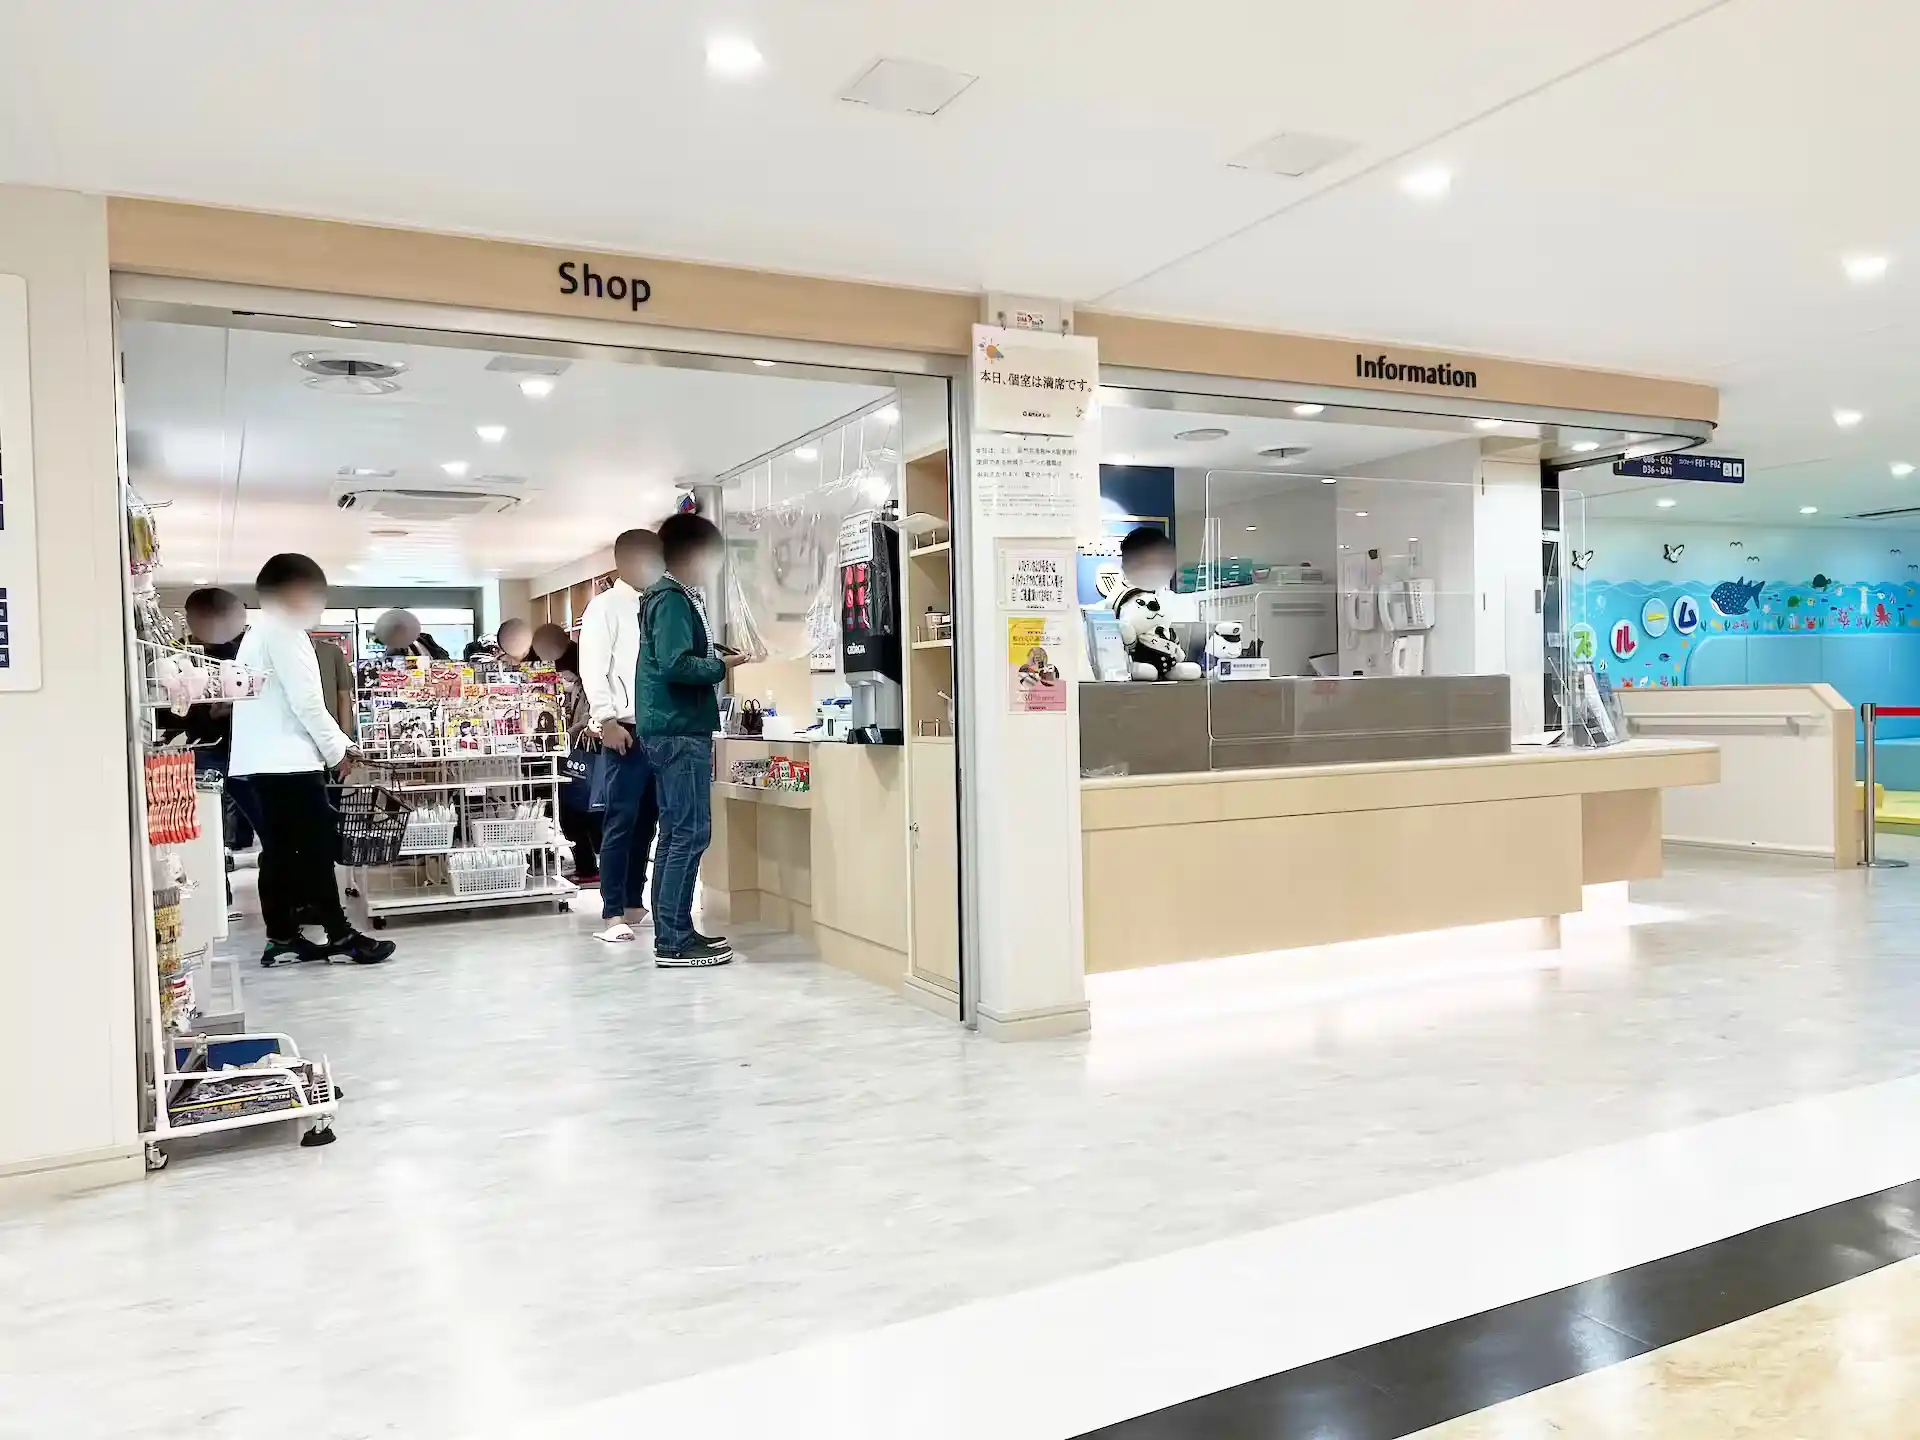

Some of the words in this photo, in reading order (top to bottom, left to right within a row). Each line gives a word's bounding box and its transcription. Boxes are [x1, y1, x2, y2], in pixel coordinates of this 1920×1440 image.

[558, 262, 651, 311] Shop
[980, 370, 1092, 392] 本日、個室は満席です。
[1356, 354, 1477, 388] Information
[691, 957, 718, 965] crocs
